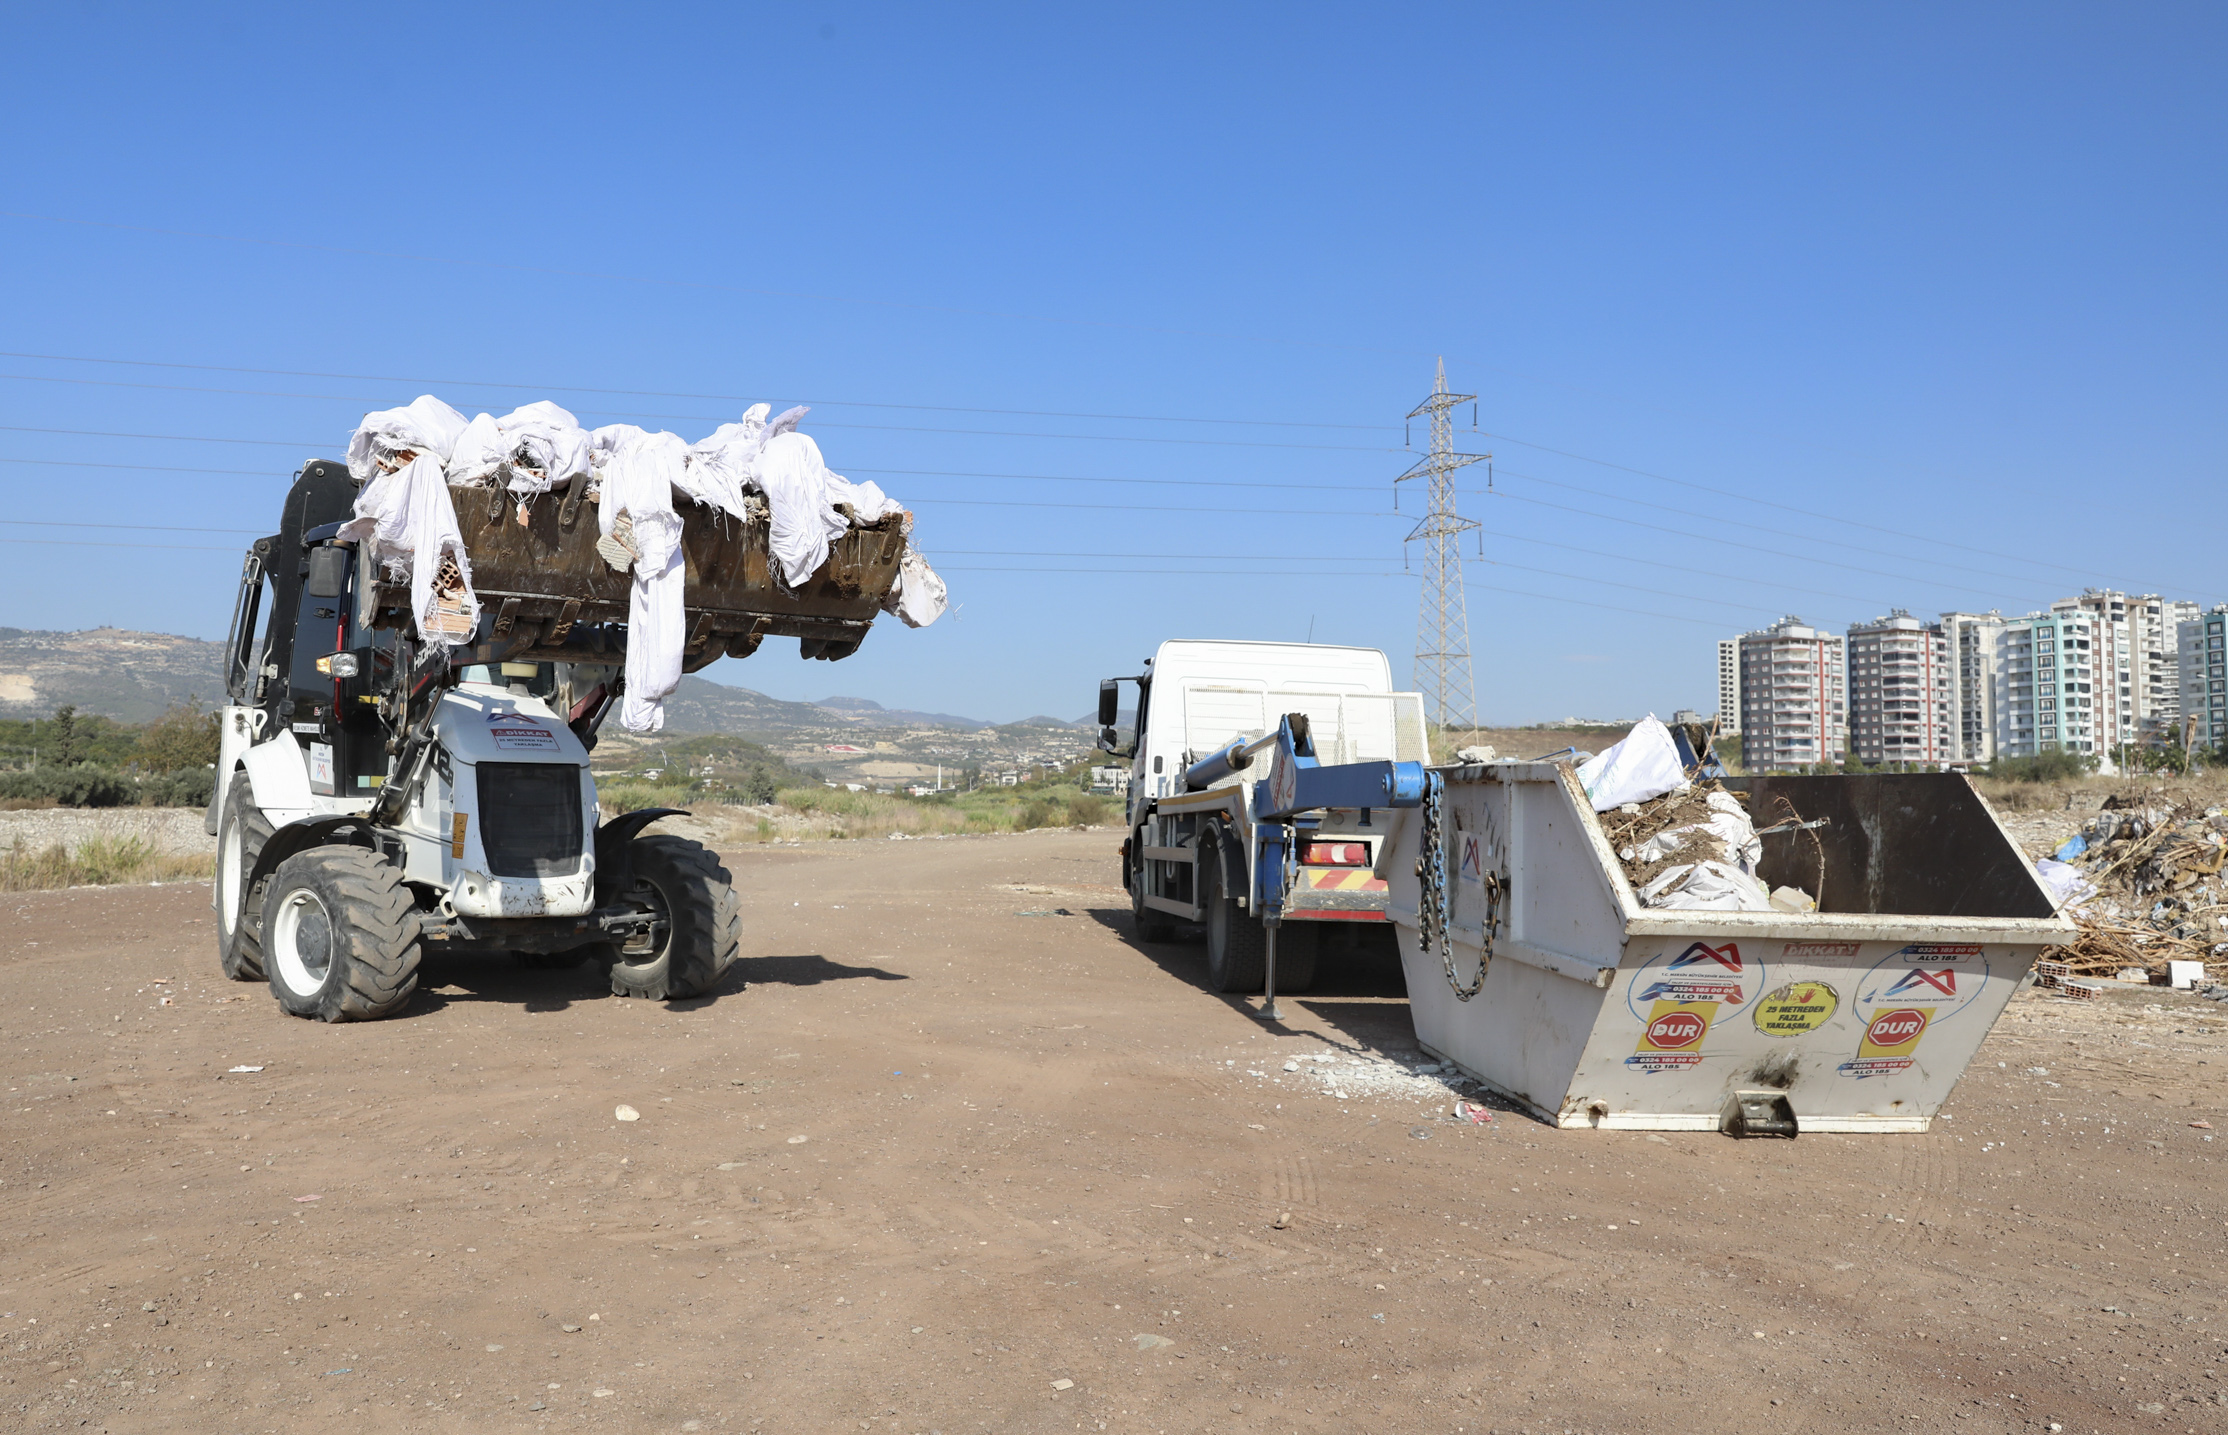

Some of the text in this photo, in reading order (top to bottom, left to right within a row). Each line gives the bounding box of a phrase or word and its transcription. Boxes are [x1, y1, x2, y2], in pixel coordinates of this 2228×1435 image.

[1652, 1024, 1697, 1037] DUR
[1766, 1022, 1811, 1030] YAKLAŞMA
[1873, 1021, 1918, 1034] DUR
